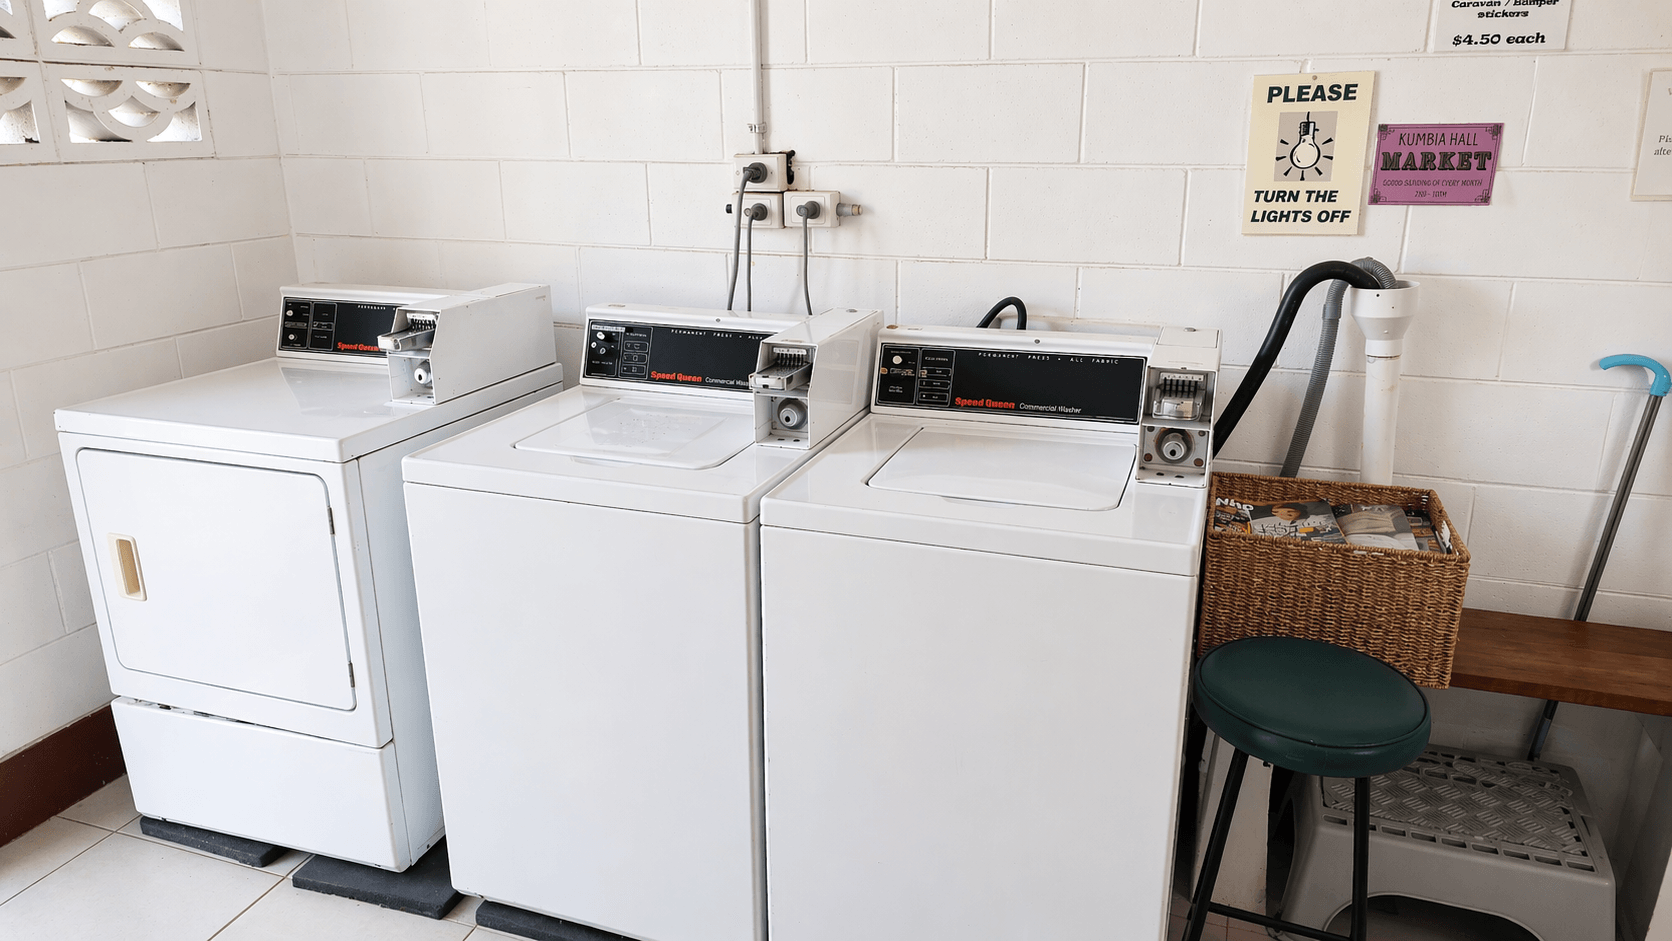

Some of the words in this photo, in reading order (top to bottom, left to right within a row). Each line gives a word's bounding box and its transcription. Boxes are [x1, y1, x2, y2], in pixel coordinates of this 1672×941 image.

[1451, 0, 1501, 8] Caravan
[1477, 9, 1529, 18] stickers
[1452, 34, 1501, 47] $4.50
[1506, 32, 1546, 44] each
[1267, 83, 1358, 103] PLEASE
[1398, 133, 1446, 146] KUMBIA
[1449, 132, 1478, 146] HALL
[1380, 151, 1492, 171] MARKET
[1254, 190, 1300, 203] TURN
[1305, 190, 1339, 203] THE
[1250, 210, 1312, 223] LIGHTS
[1317, 210, 1352, 223] OFF
[651, 370, 676, 380] Speed
[677, 373, 702, 382] Queen
[955, 397, 984, 408] Speed
[985, 398, 1015, 409] Queen
[1019, 402, 1057, 412] Commercial
[1058, 405, 1082, 414] Washer
